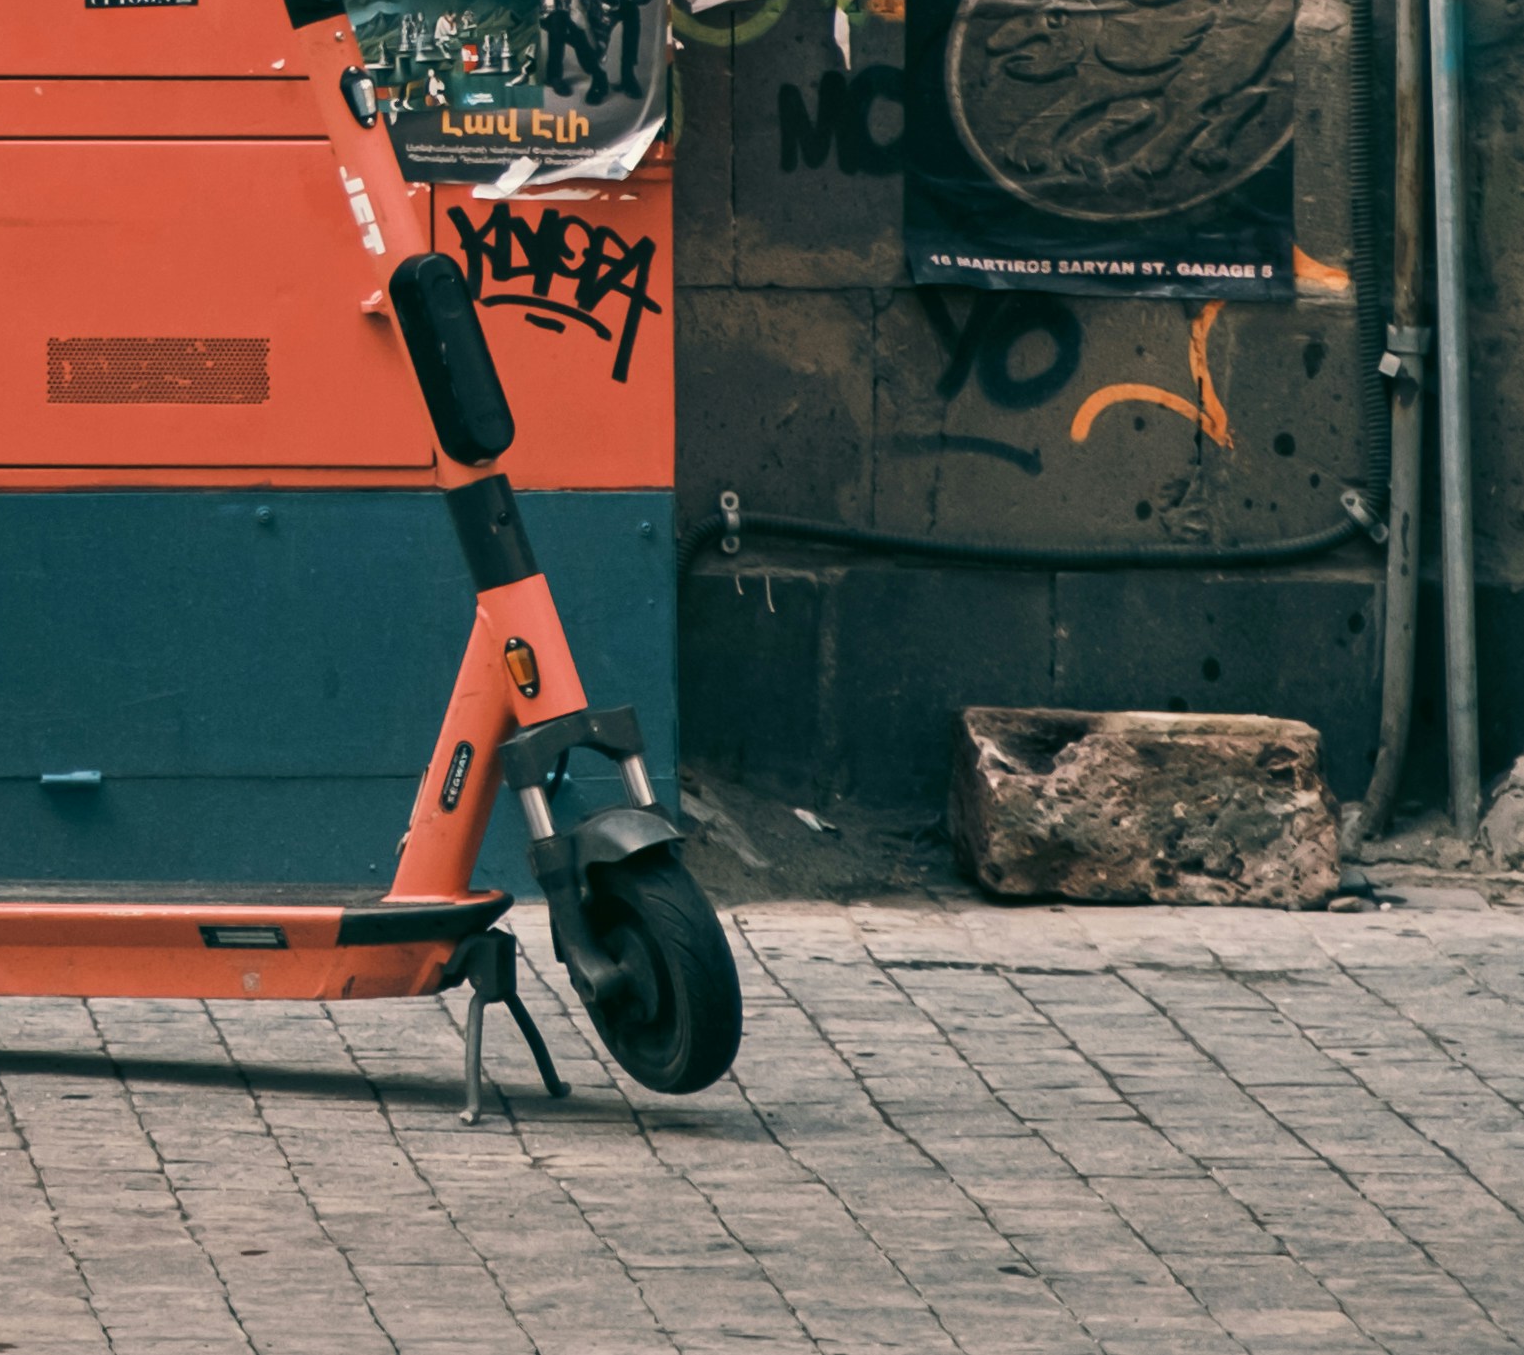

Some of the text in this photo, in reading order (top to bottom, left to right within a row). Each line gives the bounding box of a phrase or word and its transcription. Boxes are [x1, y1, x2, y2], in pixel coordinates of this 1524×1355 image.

[442, 108, 590, 145] Լավ Էլի
[339, 165, 386, 255] JET
